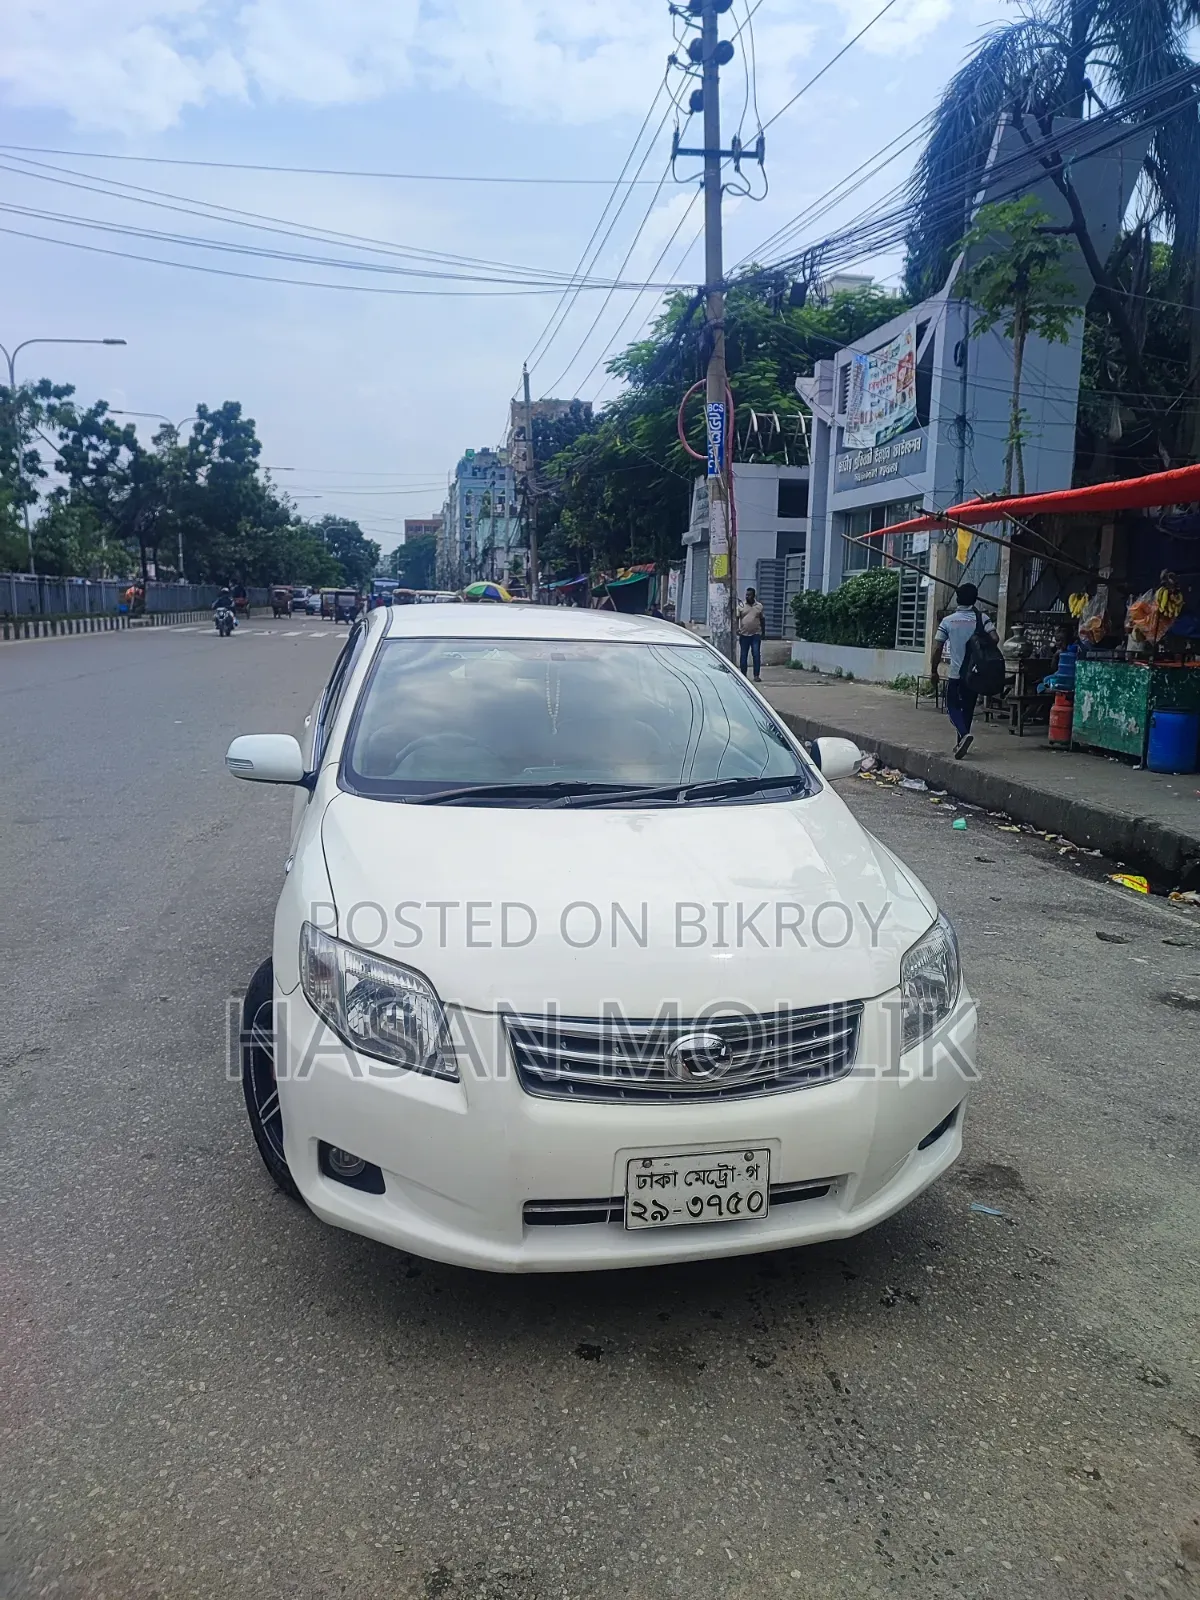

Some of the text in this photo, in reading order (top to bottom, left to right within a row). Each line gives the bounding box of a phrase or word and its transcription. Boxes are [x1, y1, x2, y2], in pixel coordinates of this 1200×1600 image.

[708, 403, 724, 413] BCS
[636, 1170, 678, 1189] ঢাকা
[631, 1190, 763, 1222] ২৯-৩৭৫০
